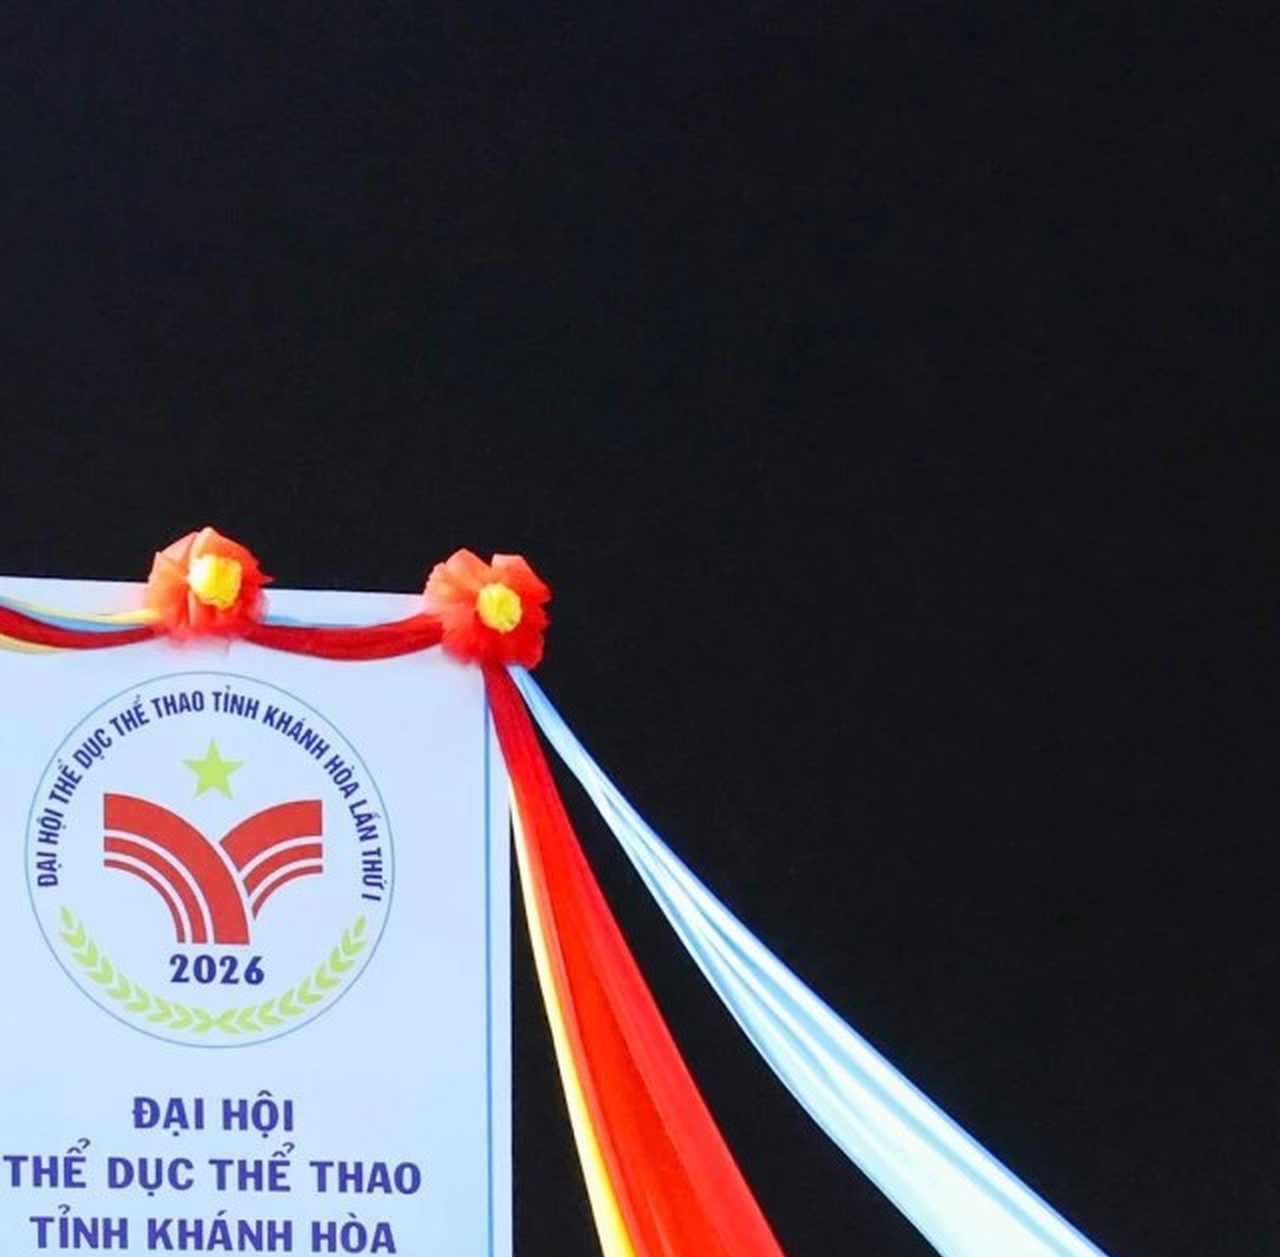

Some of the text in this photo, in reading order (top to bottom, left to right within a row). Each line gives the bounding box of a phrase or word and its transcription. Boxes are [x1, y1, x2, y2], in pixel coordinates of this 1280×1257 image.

[150, 690, 205, 719] THAO
[72, 728, 113, 770] DỤC
[262, 704, 330, 760] KHÁNH
[323, 754, 360, 799] HÒA
[36, 807, 67, 845] HỘI
[36, 852, 62, 887] ĐẠI
[362, 893, 382, 902] I
[169, 953, 264, 985] 2026
[132, 1089, 294, 1139] ĐẠI HỘI
[3, 1137, 422, 1197] THỂ DỤC THỂ THAO
[29, 1203, 397, 1255] TỈNH KHÁNH HÒA
